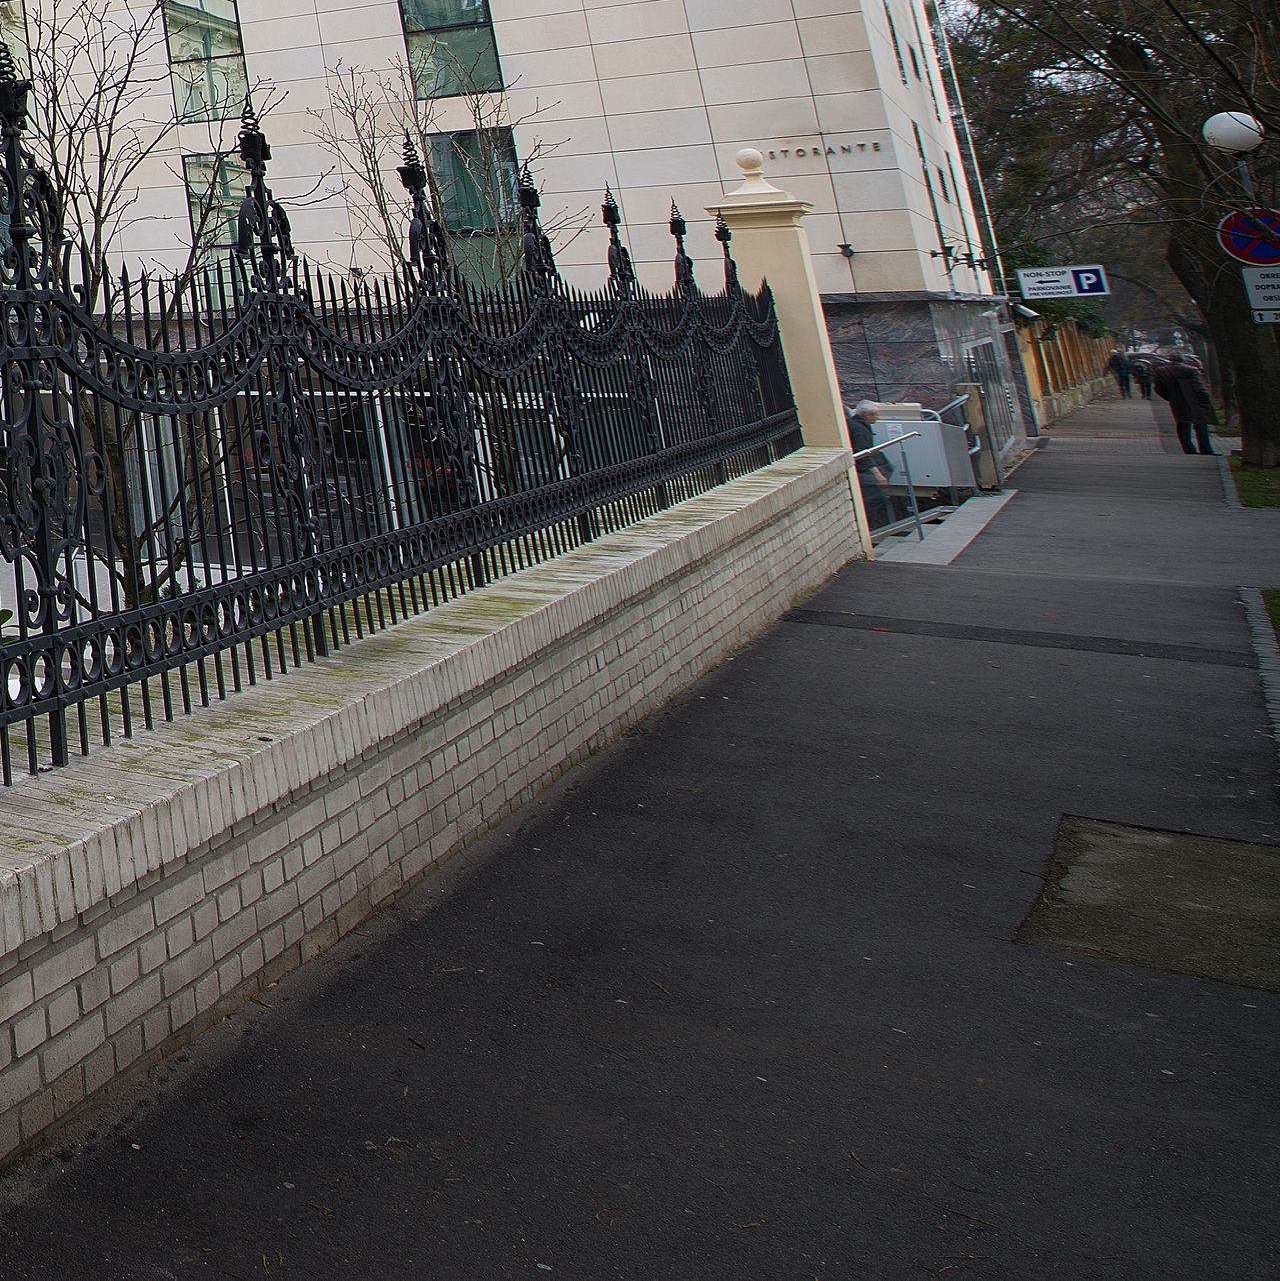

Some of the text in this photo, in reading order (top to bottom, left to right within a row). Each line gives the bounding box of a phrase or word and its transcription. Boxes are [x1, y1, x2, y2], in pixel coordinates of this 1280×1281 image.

[759, 142, 881, 161] STORANTE
[1023, 270, 1097, 290] NON-STOP P
